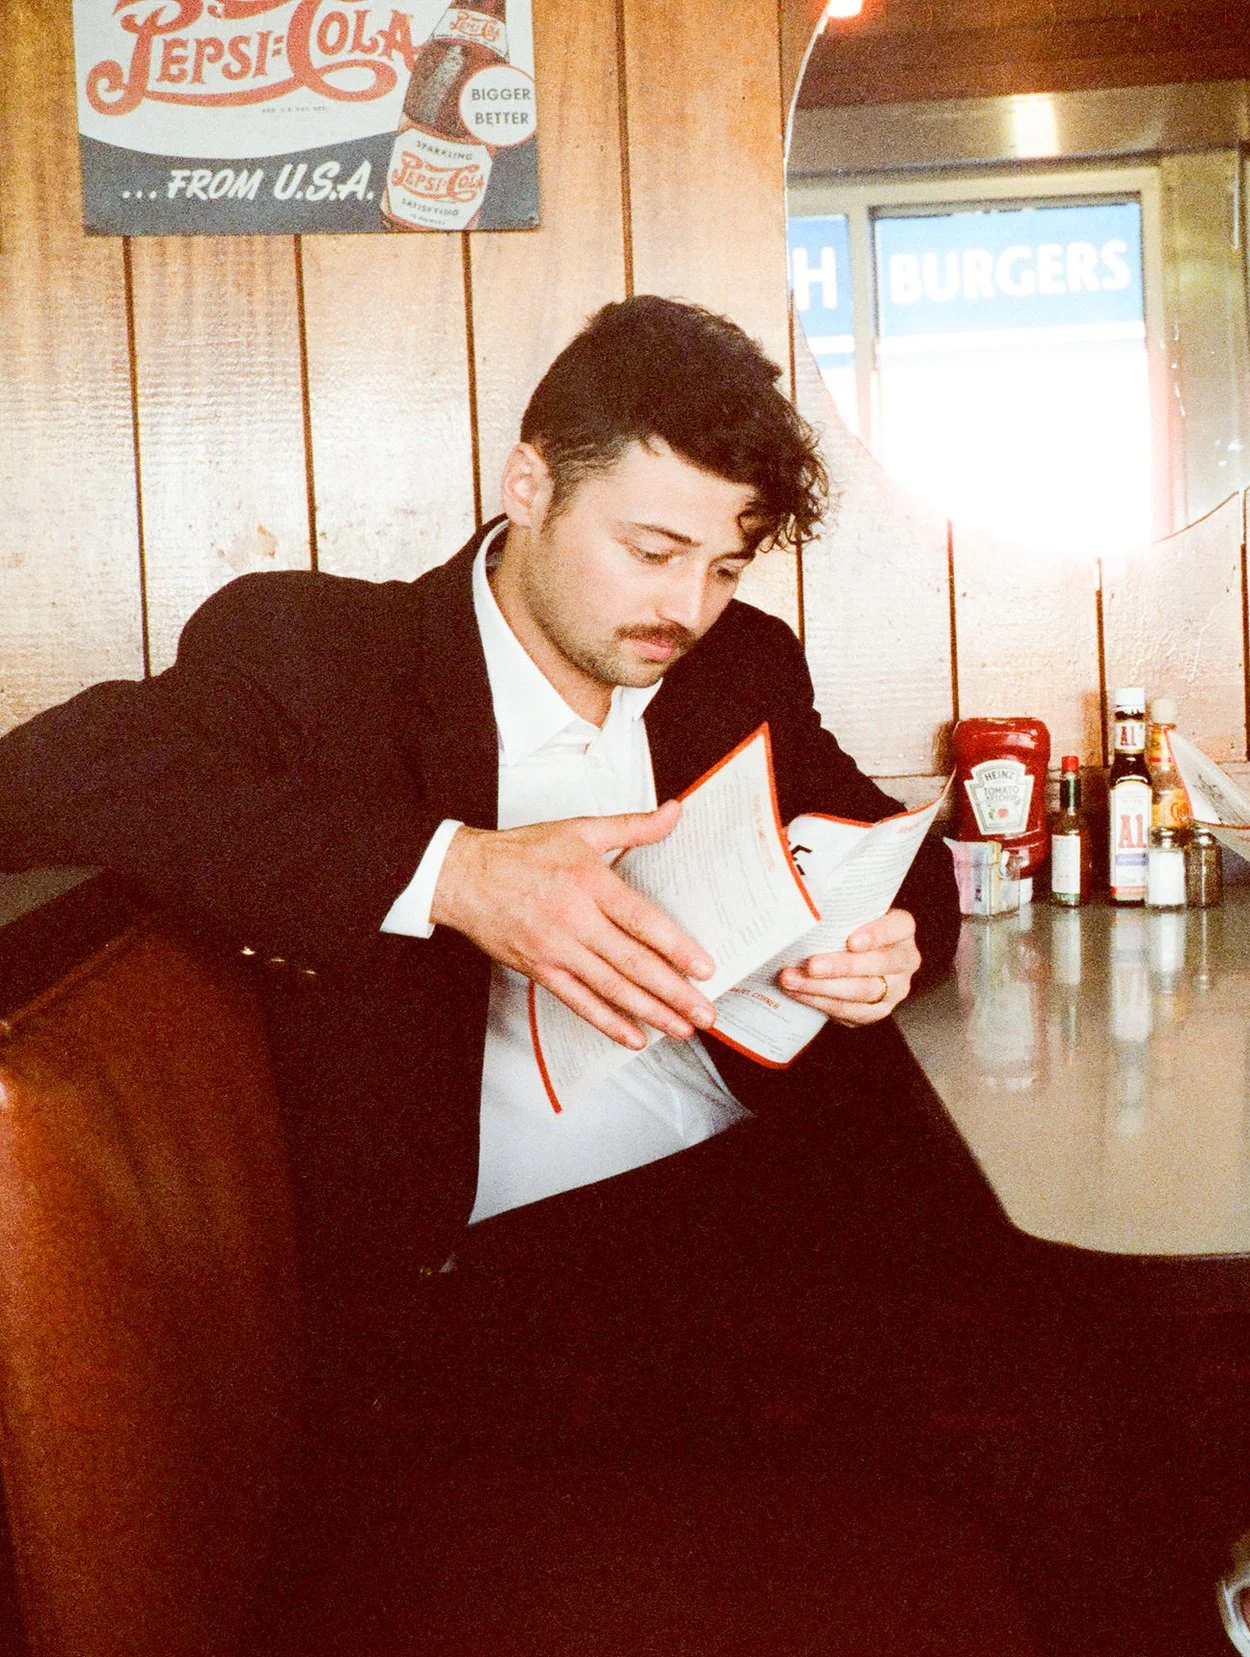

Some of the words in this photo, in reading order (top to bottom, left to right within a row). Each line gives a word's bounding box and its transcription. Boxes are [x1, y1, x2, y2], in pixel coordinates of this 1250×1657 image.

[471, 88, 531, 101] BIGGER
[475, 112, 529, 125] BETTER
[274, 160, 374, 200] U.S.A.
[889, 239, 1132, 304] BURGERS
[984, 770, 1016, 782] HEINZ
[984, 785, 1020, 797] TOMATO
